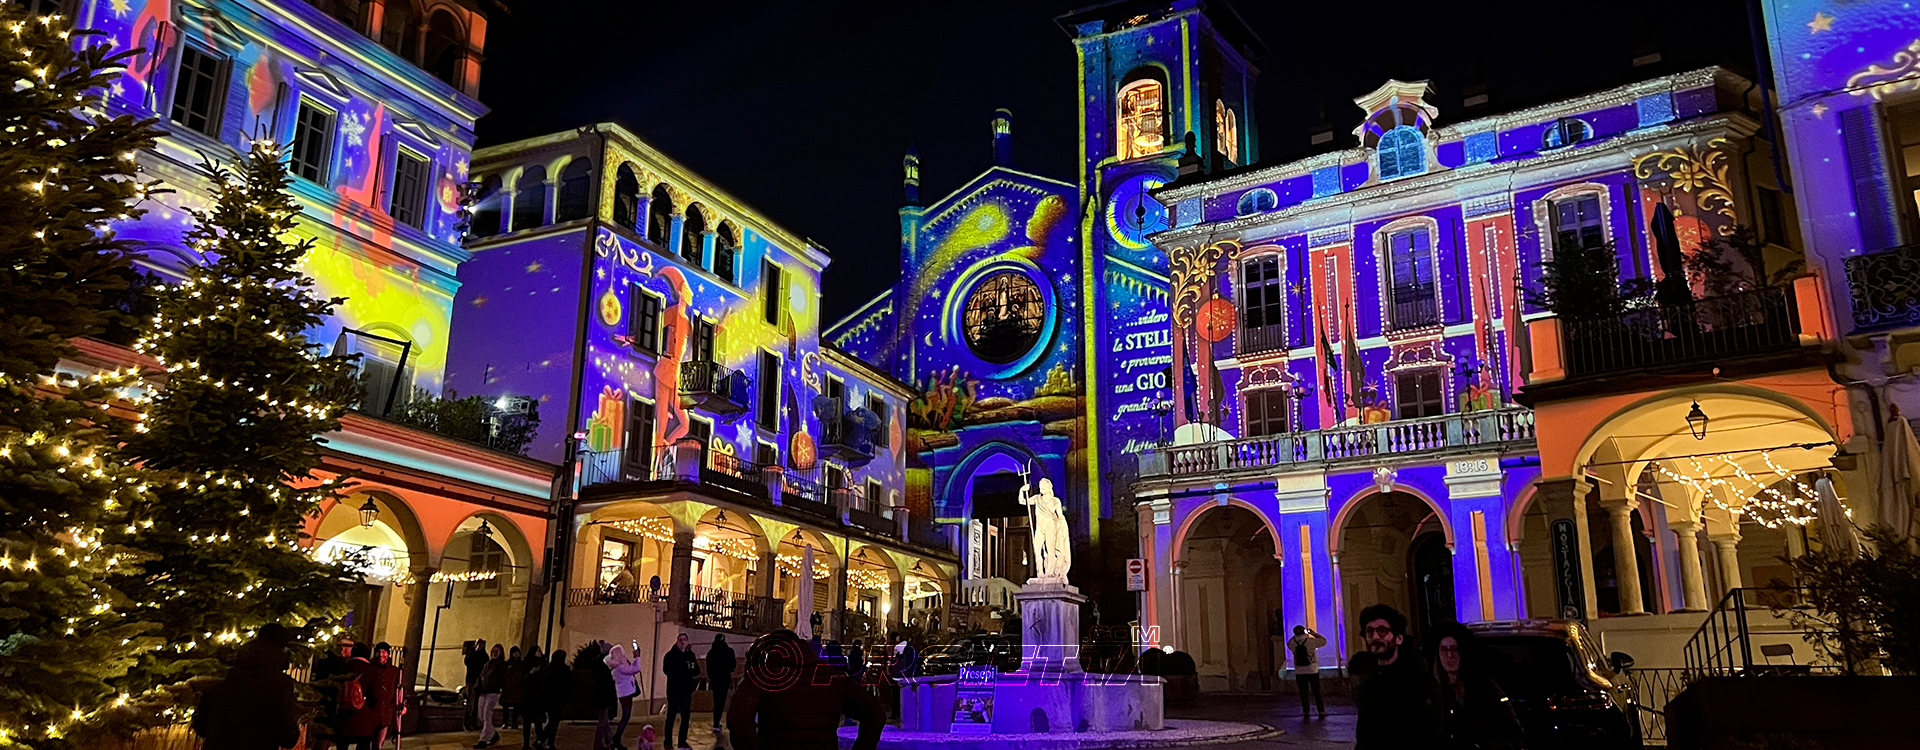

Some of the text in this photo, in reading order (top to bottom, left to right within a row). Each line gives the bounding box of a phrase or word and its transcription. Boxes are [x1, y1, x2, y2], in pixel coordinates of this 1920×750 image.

[1112, 338, 1123, 352] la
[1120, 360, 1127, 369] e
[1115, 383, 1134, 394] una
[959, 666, 995, 681] Presepi
